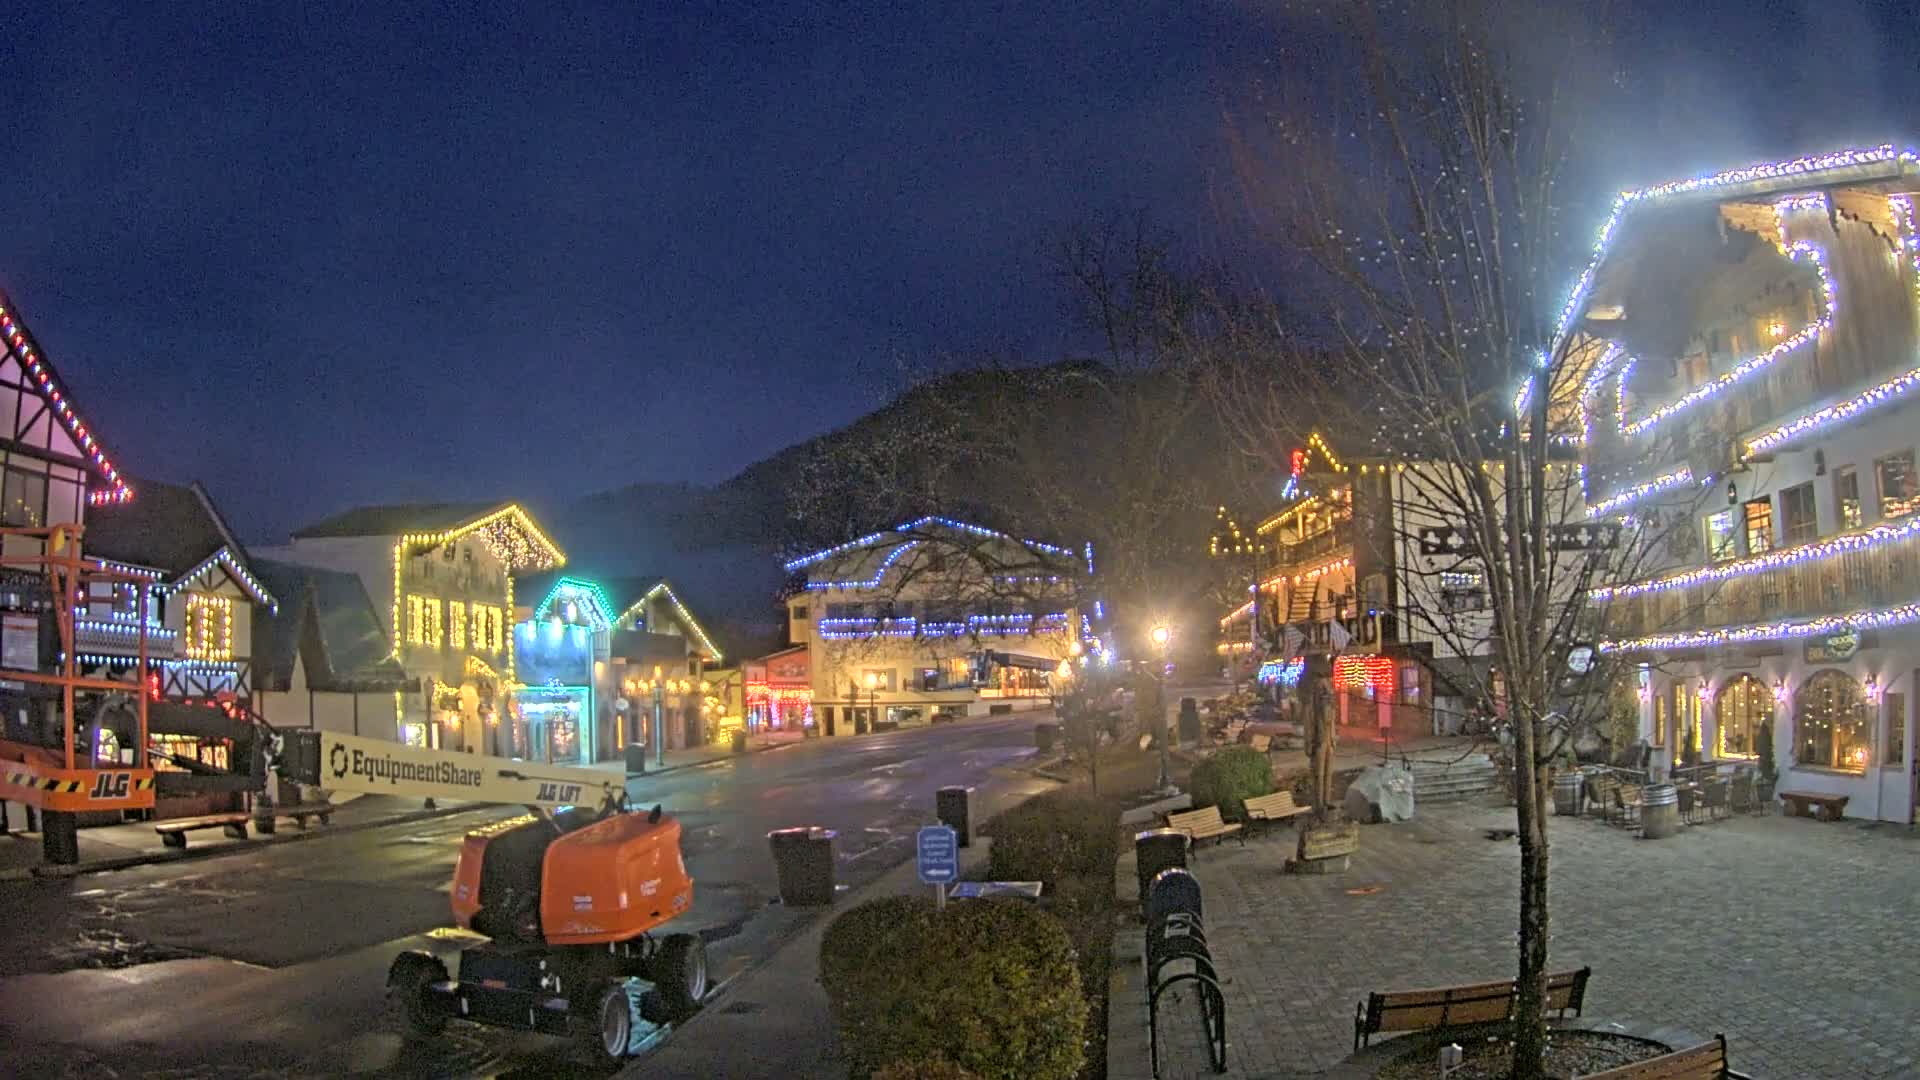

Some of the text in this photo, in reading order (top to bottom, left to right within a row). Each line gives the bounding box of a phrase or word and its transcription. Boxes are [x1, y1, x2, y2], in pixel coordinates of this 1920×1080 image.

[352, 749, 481, 787] EquipmentShare
[90, 772, 131, 798] JLG
[536, 783, 582, 803] JLG LIFT
